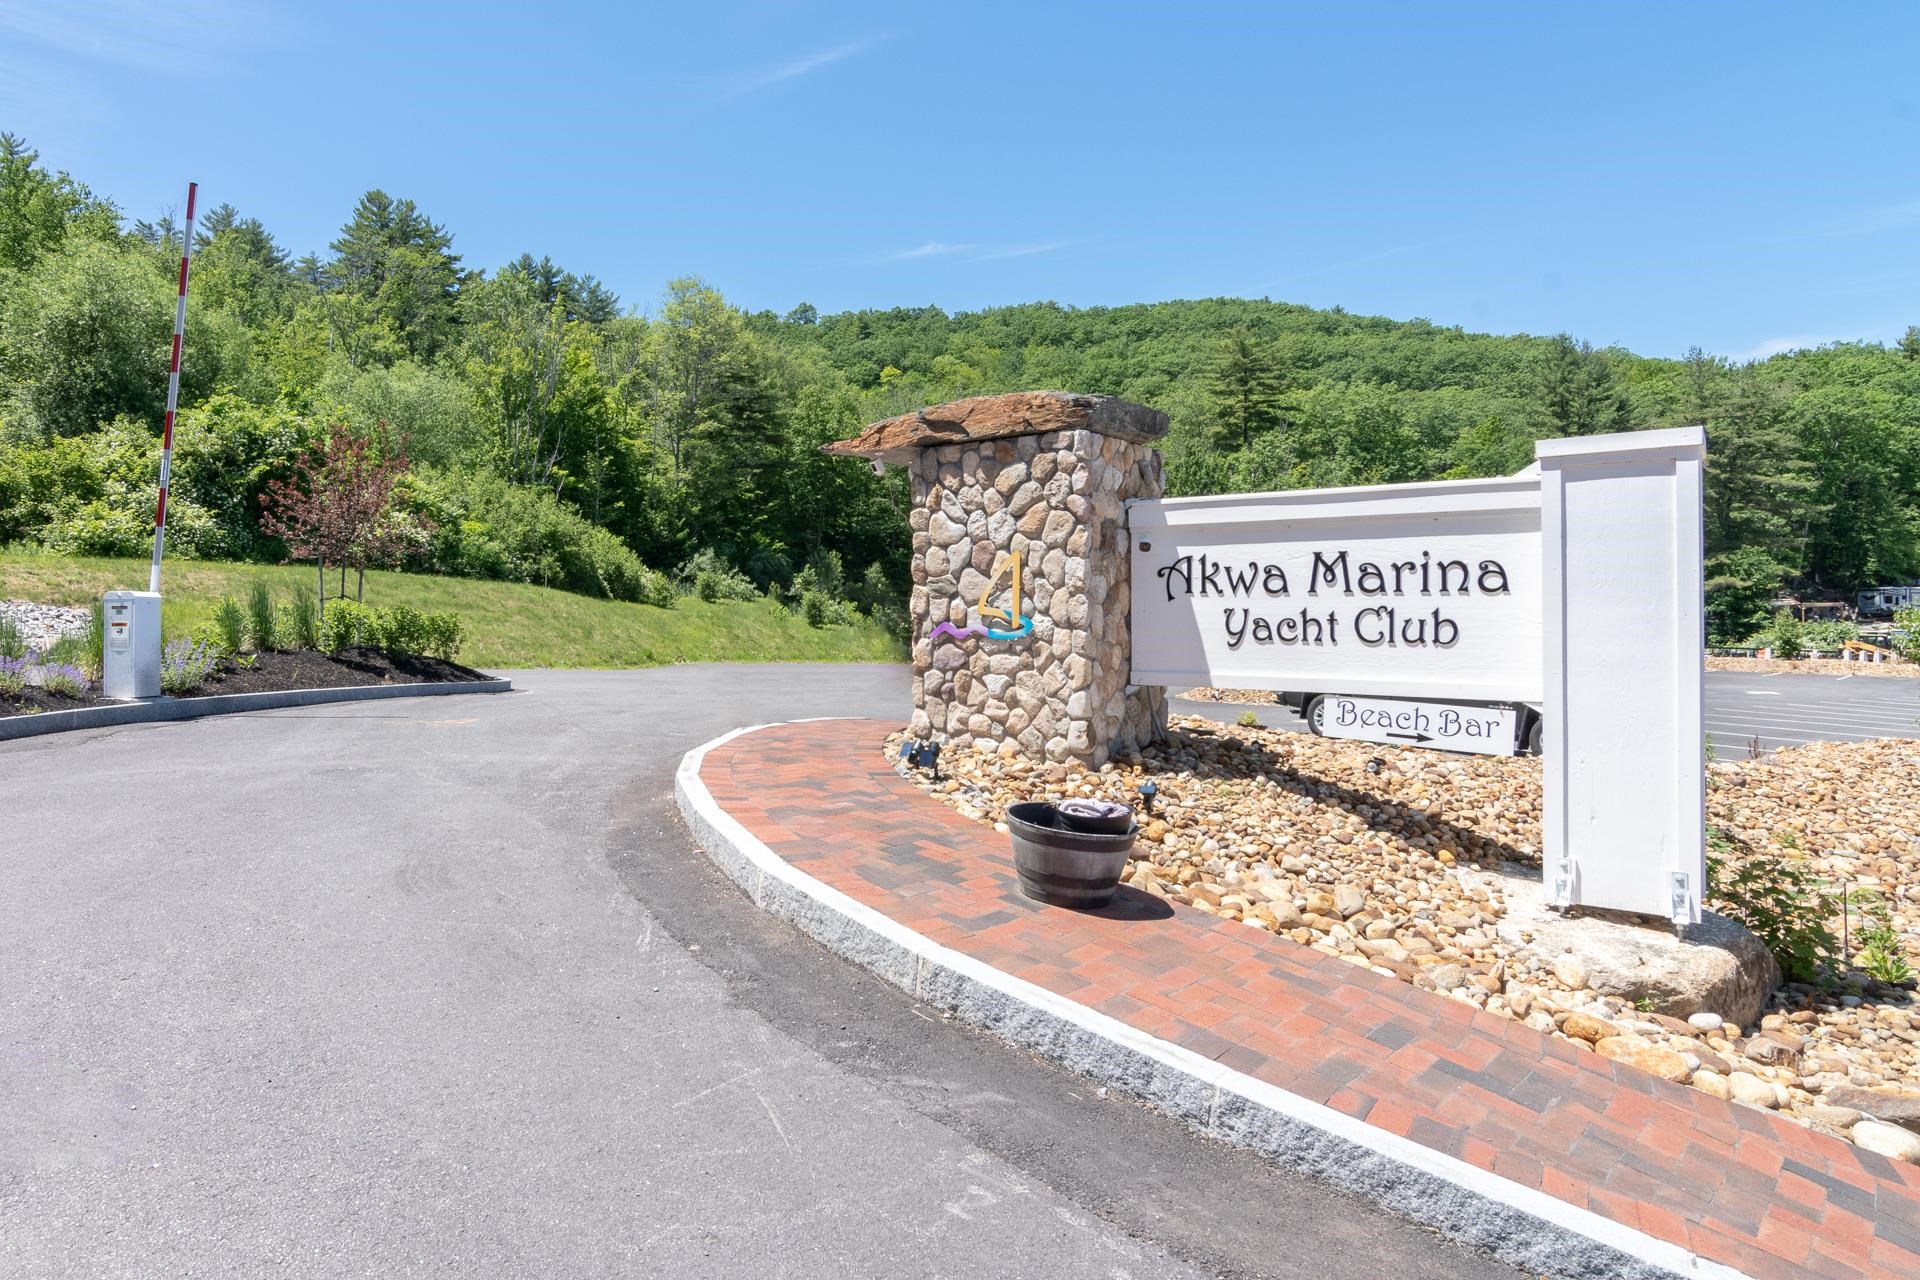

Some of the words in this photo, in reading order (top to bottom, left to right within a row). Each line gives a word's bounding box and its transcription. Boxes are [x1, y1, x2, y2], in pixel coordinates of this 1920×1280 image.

[1157, 552, 1290, 602] Akwa
[1308, 550, 1510, 596] Marina
[1224, 607, 1339, 649] Yacht
[1354, 605, 1460, 646] Club
[1336, 700, 1430, 733] Beach
[1438, 709, 1501, 739] Bar
